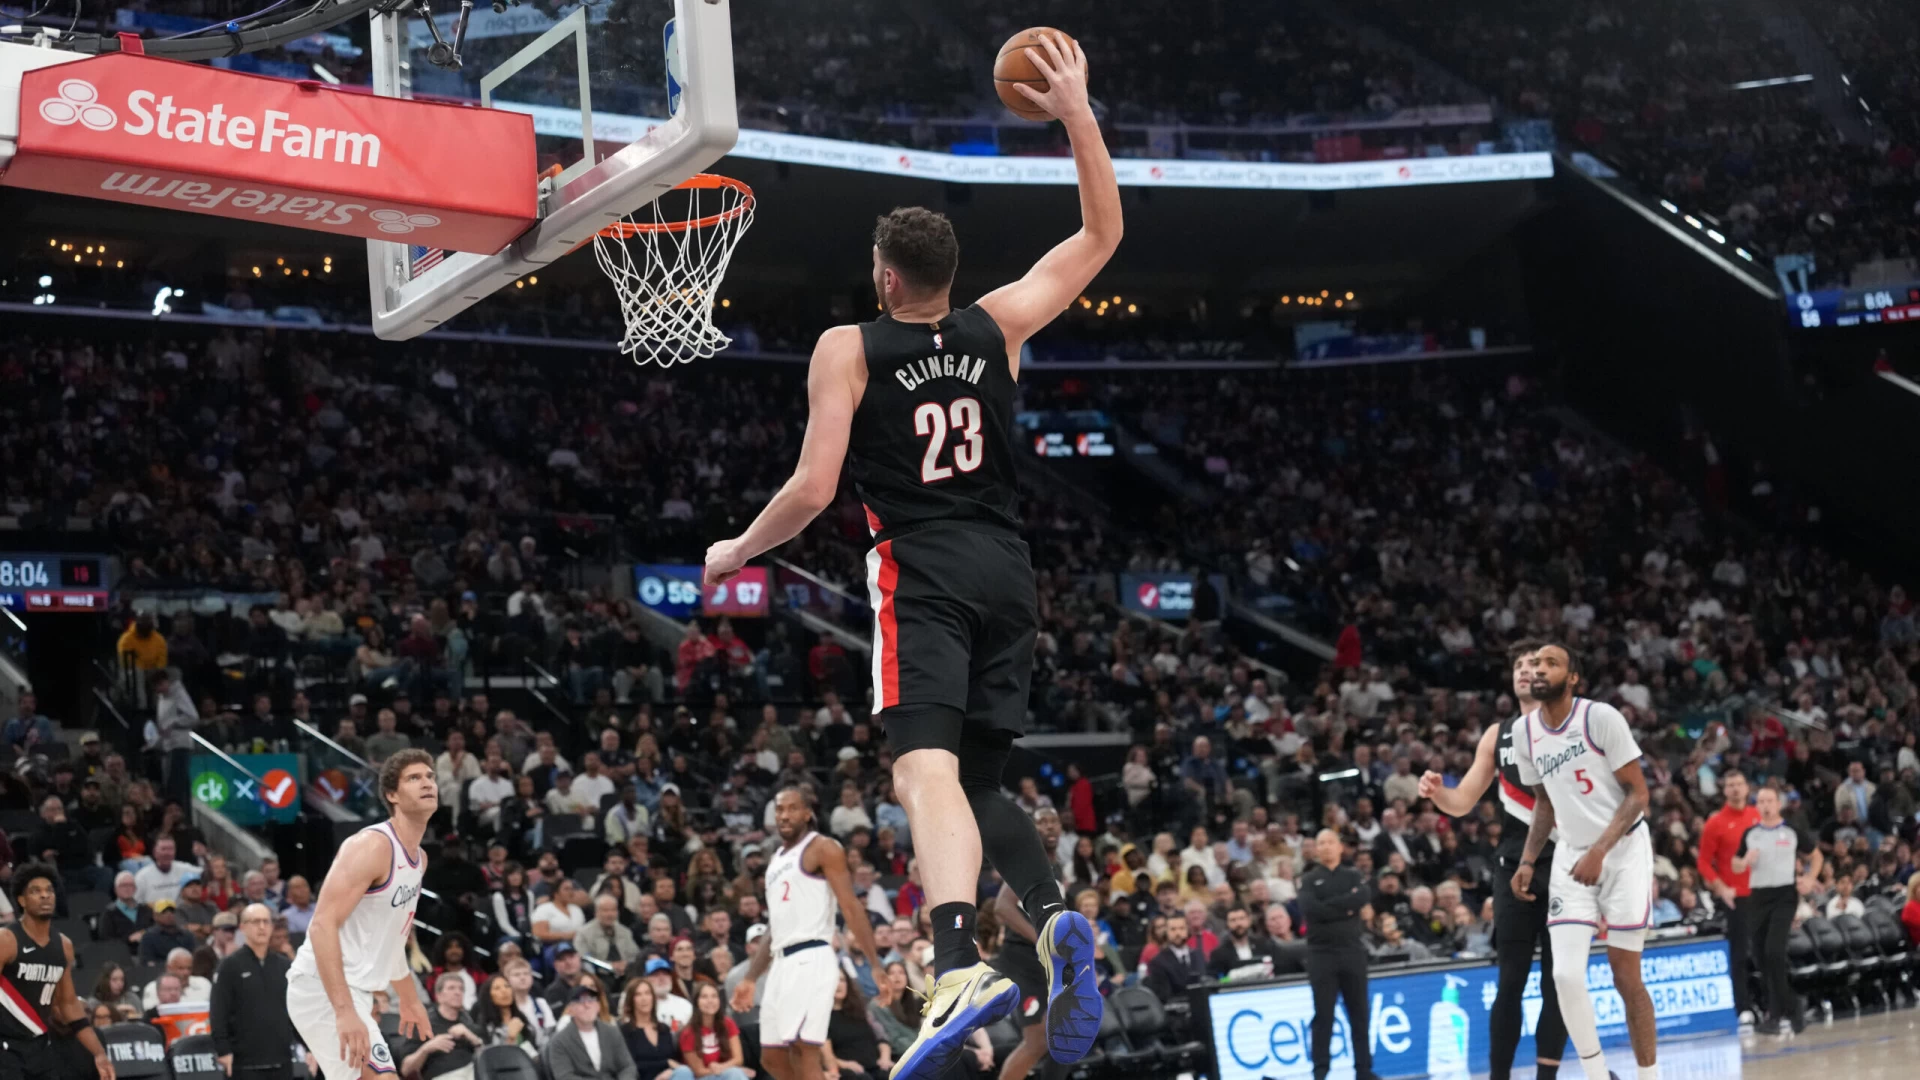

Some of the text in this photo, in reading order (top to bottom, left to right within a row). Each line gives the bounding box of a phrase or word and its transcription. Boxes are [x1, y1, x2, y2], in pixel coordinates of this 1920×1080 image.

[895, 354, 987, 391] CLINGAN
[913, 396, 985, 484] 23
[0, 561, 49, 587] 8:04
[736, 581, 762, 605] 67
[1536, 741, 1588, 779] Clippers
[196, 778, 223, 802] ck
[1574, 769, 1594, 795] 5
[782, 880, 791, 902] 2
[1653, 983, 1720, 1013] BRAND
[112, 1043, 134, 1062] THE
[173, 1054, 194, 1073] GET
